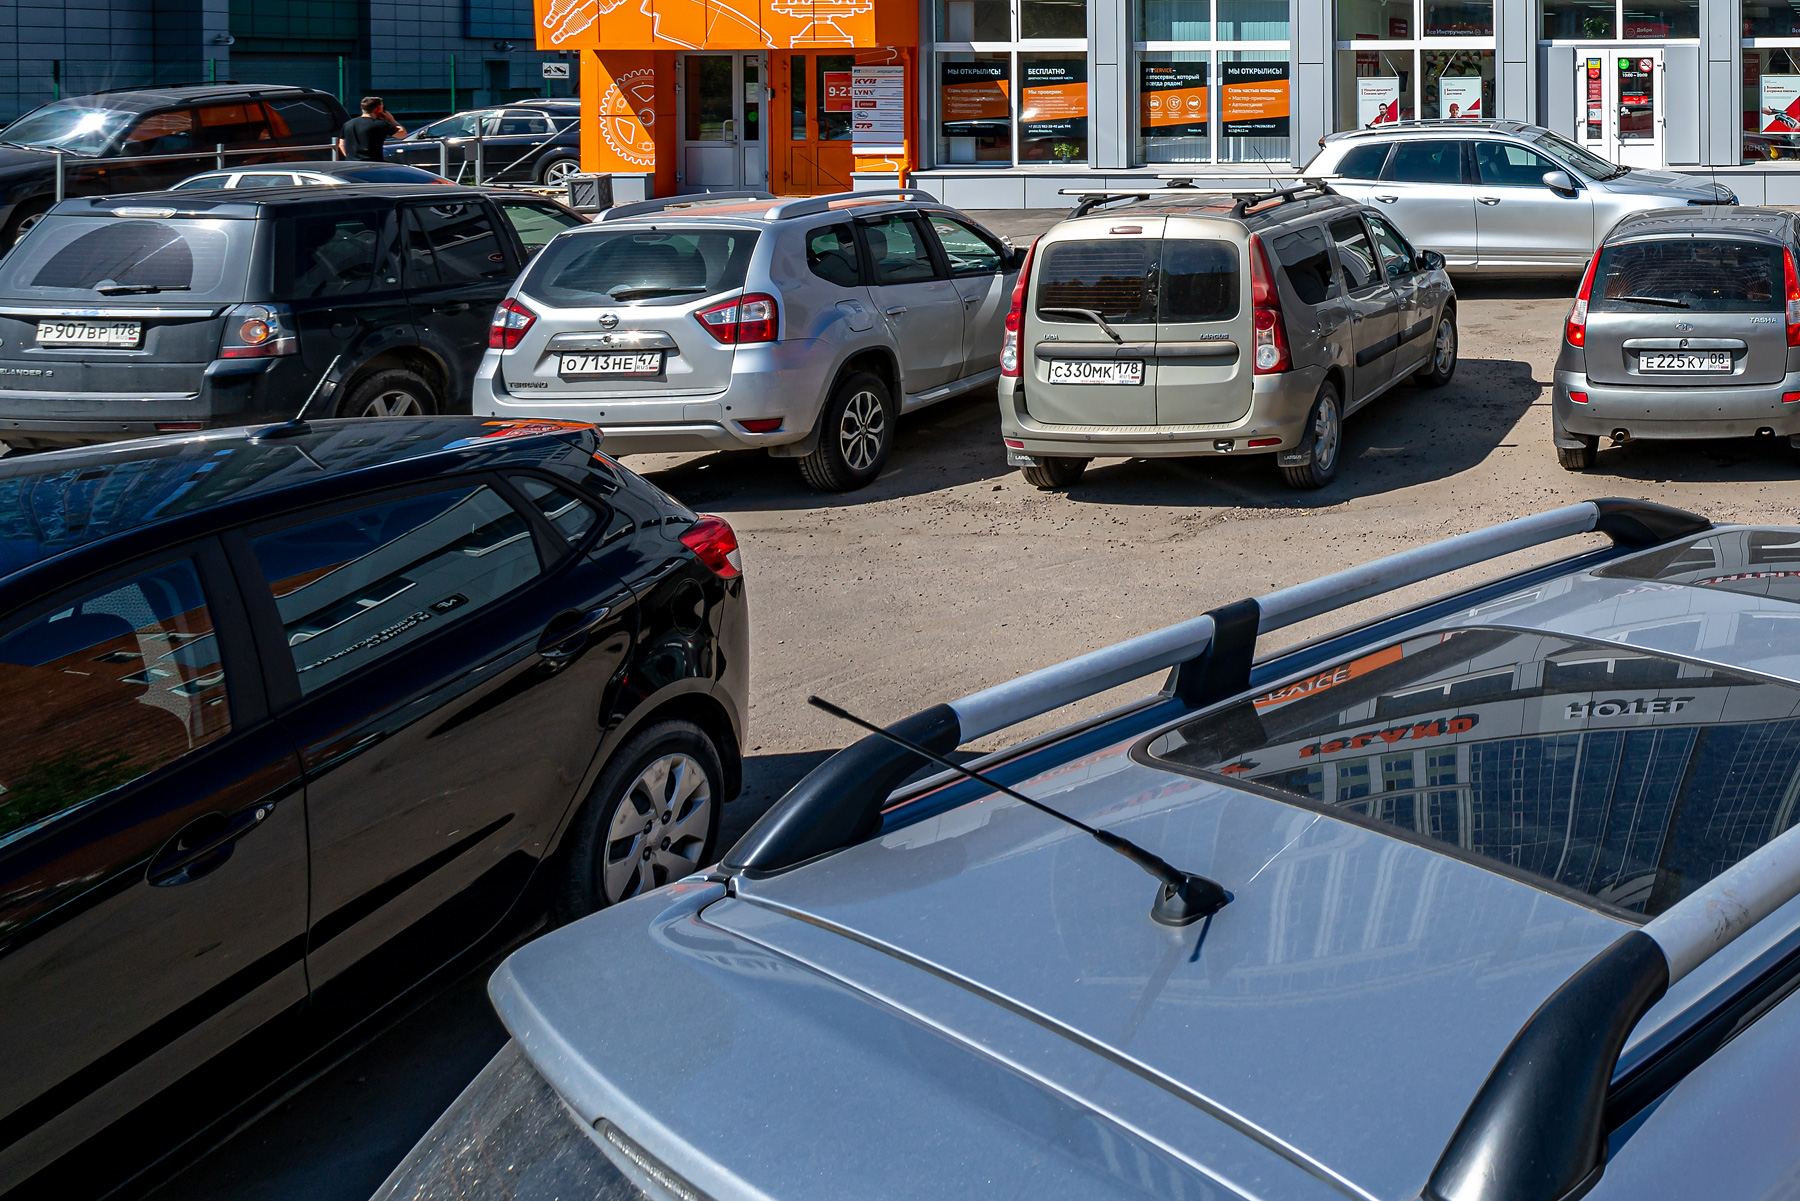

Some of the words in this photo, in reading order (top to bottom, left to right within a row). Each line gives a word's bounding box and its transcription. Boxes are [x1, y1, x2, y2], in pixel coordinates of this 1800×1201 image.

[112, 323, 136, 335] 178
[638, 352, 657, 365] 47
[1710, 353, 1725, 364] 08
[1116, 362, 1138, 374] 178
